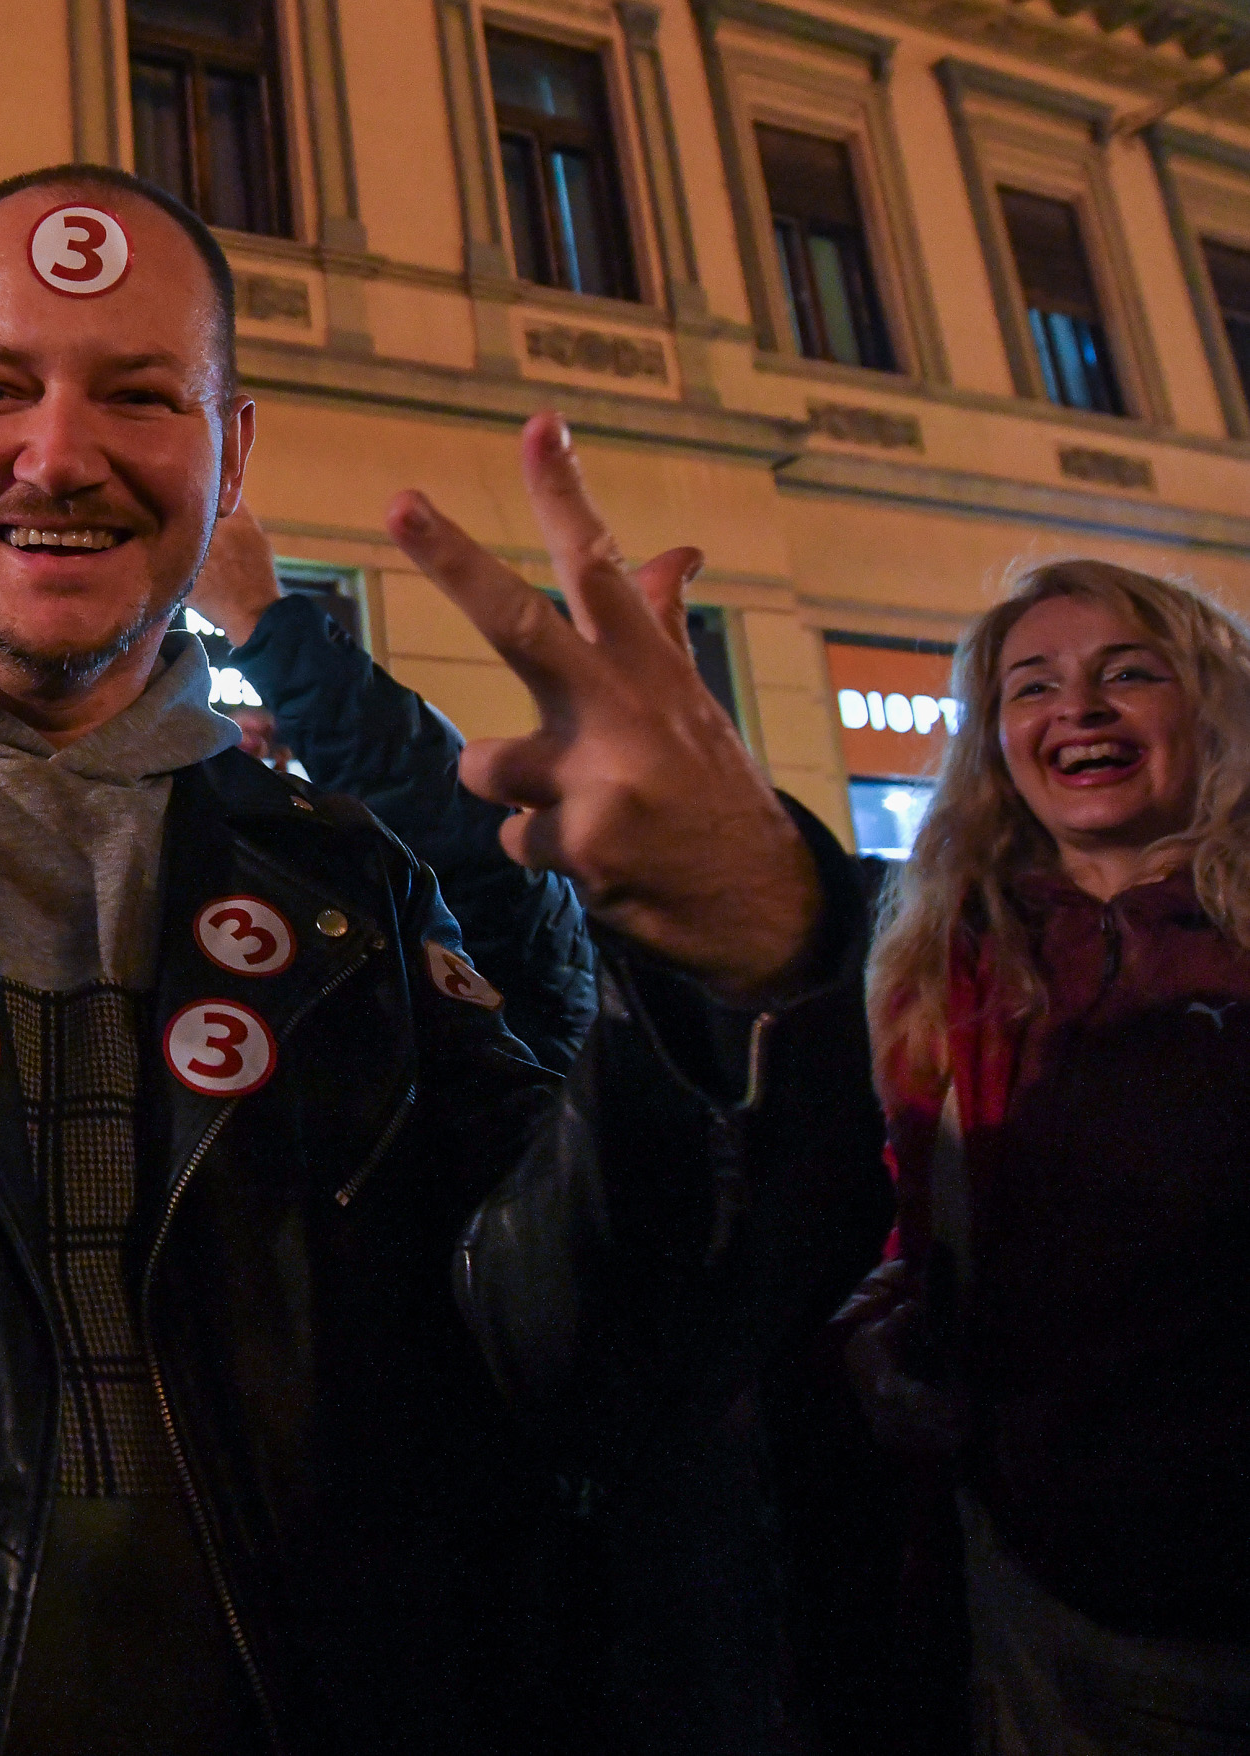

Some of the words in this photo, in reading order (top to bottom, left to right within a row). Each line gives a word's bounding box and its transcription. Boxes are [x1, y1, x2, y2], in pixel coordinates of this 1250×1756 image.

[50, 215, 107, 282] 3
[208, 907, 277, 965] 3
[187, 1012, 248, 1079] 3
